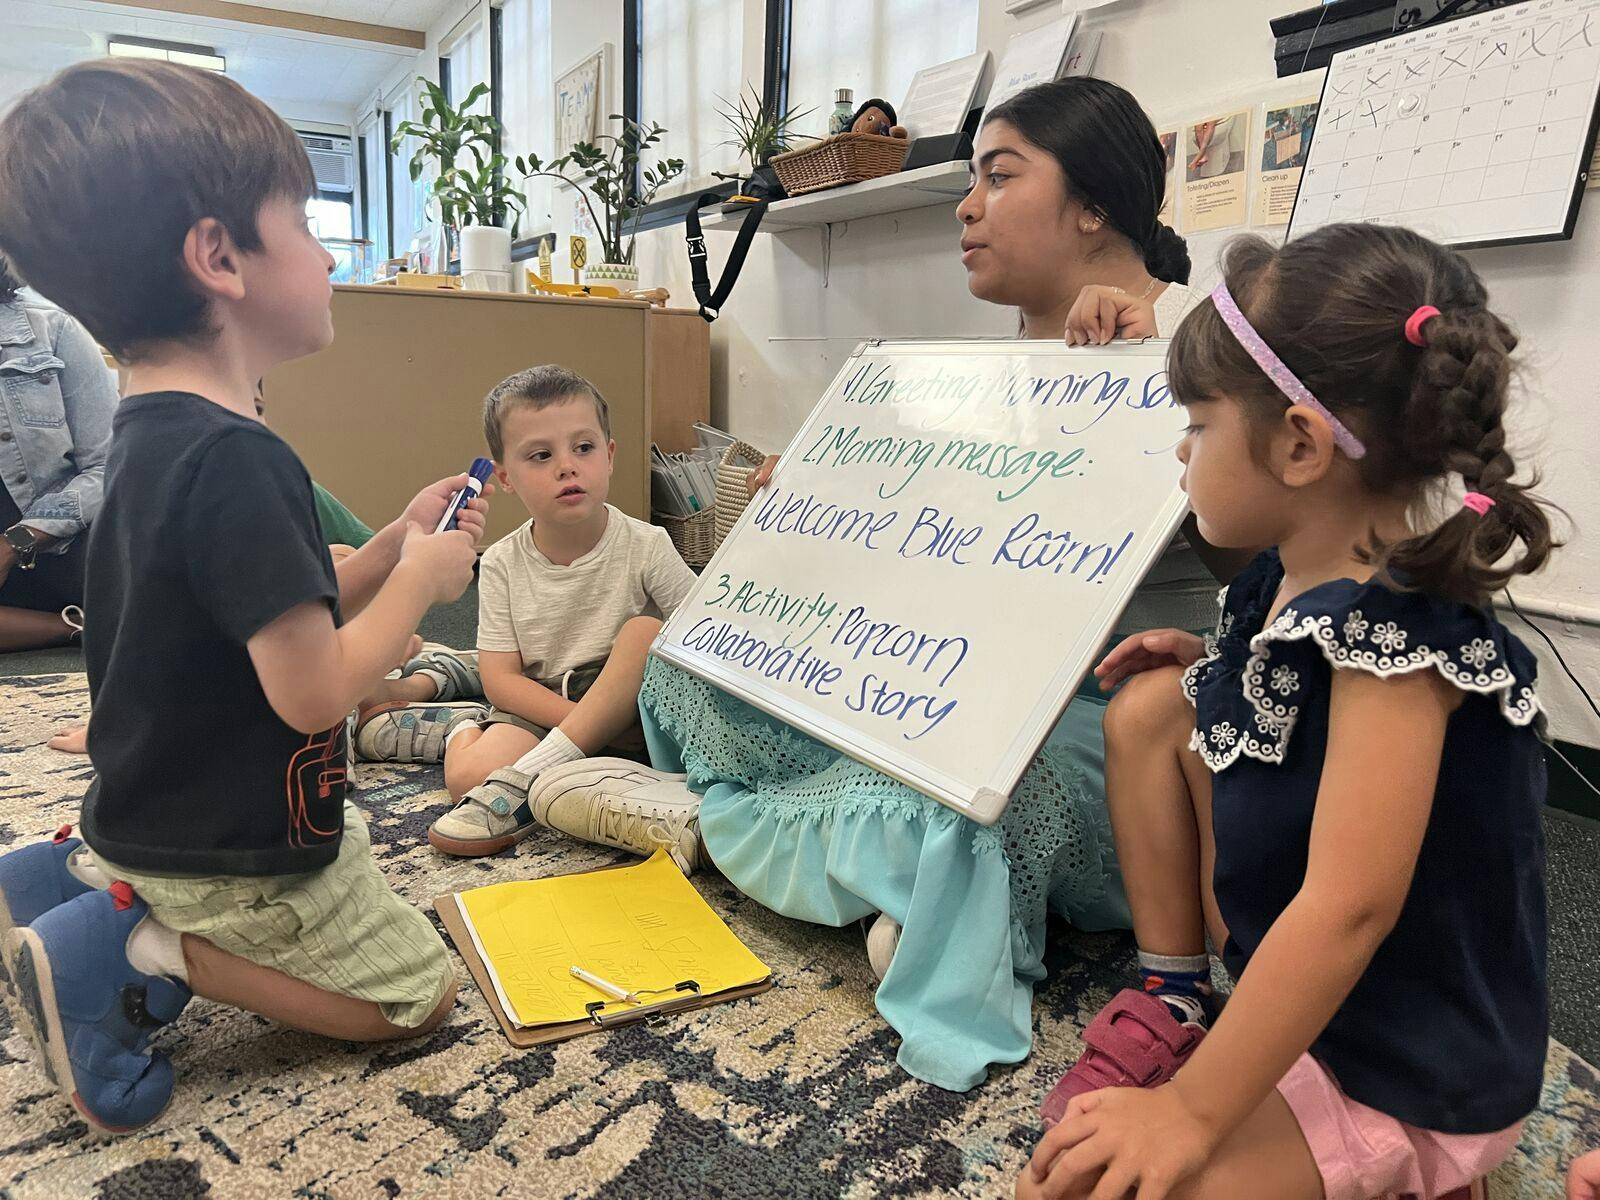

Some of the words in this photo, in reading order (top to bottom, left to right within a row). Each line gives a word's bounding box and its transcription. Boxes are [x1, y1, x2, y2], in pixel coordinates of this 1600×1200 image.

[1425, 32, 1438, 40] MAY
[1447, 26, 1459, 34] JUN
[934, 439, 1094, 502] message:
[754, 488, 898, 550] Welcome
[898, 506, 983, 565] Blue
[682, 617, 842, 696] Collaborative
[845, 673, 958, 740] Story
[830, 606, 969, 688] Popcorn
